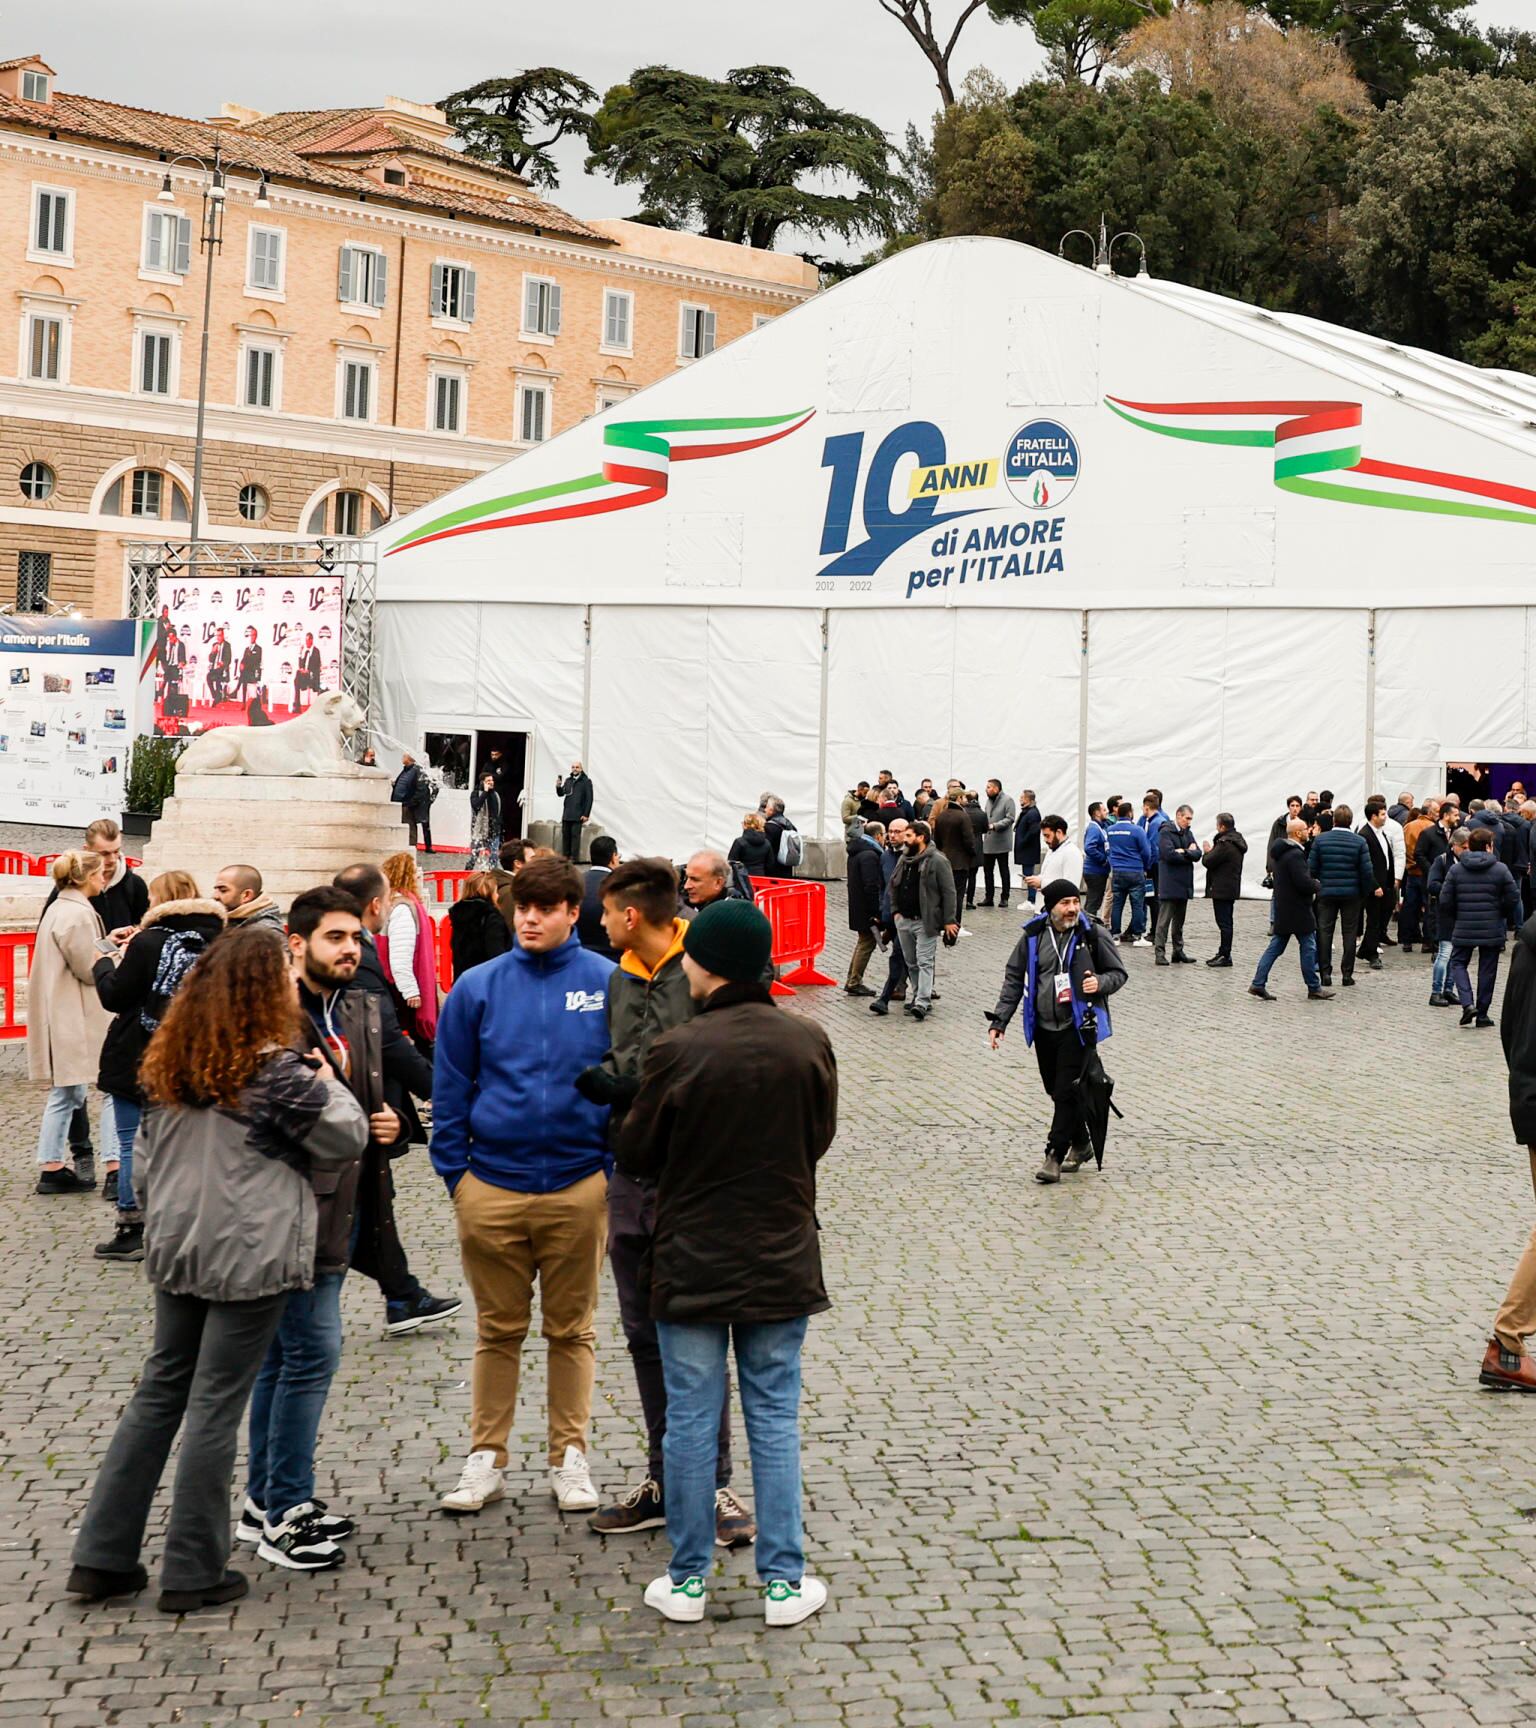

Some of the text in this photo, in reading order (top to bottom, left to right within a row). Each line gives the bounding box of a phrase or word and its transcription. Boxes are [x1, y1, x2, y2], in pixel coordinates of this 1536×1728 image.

[1016, 438, 1069, 450] FRATELLI
[1011, 452, 1074, 467] d'ITALIA
[816, 421, 989, 576] 10 ANNI
[931, 517, 1066, 558] di AMORE
[906, 548, 1065, 598] per l'ITALIA
[815, 581, 835, 591] 2012
[849, 580, 872, 591] 2022
[3, 634, 36, 645] amore
[38, 635, 56, 648] per
[565, 990, 587, 1011] 10
